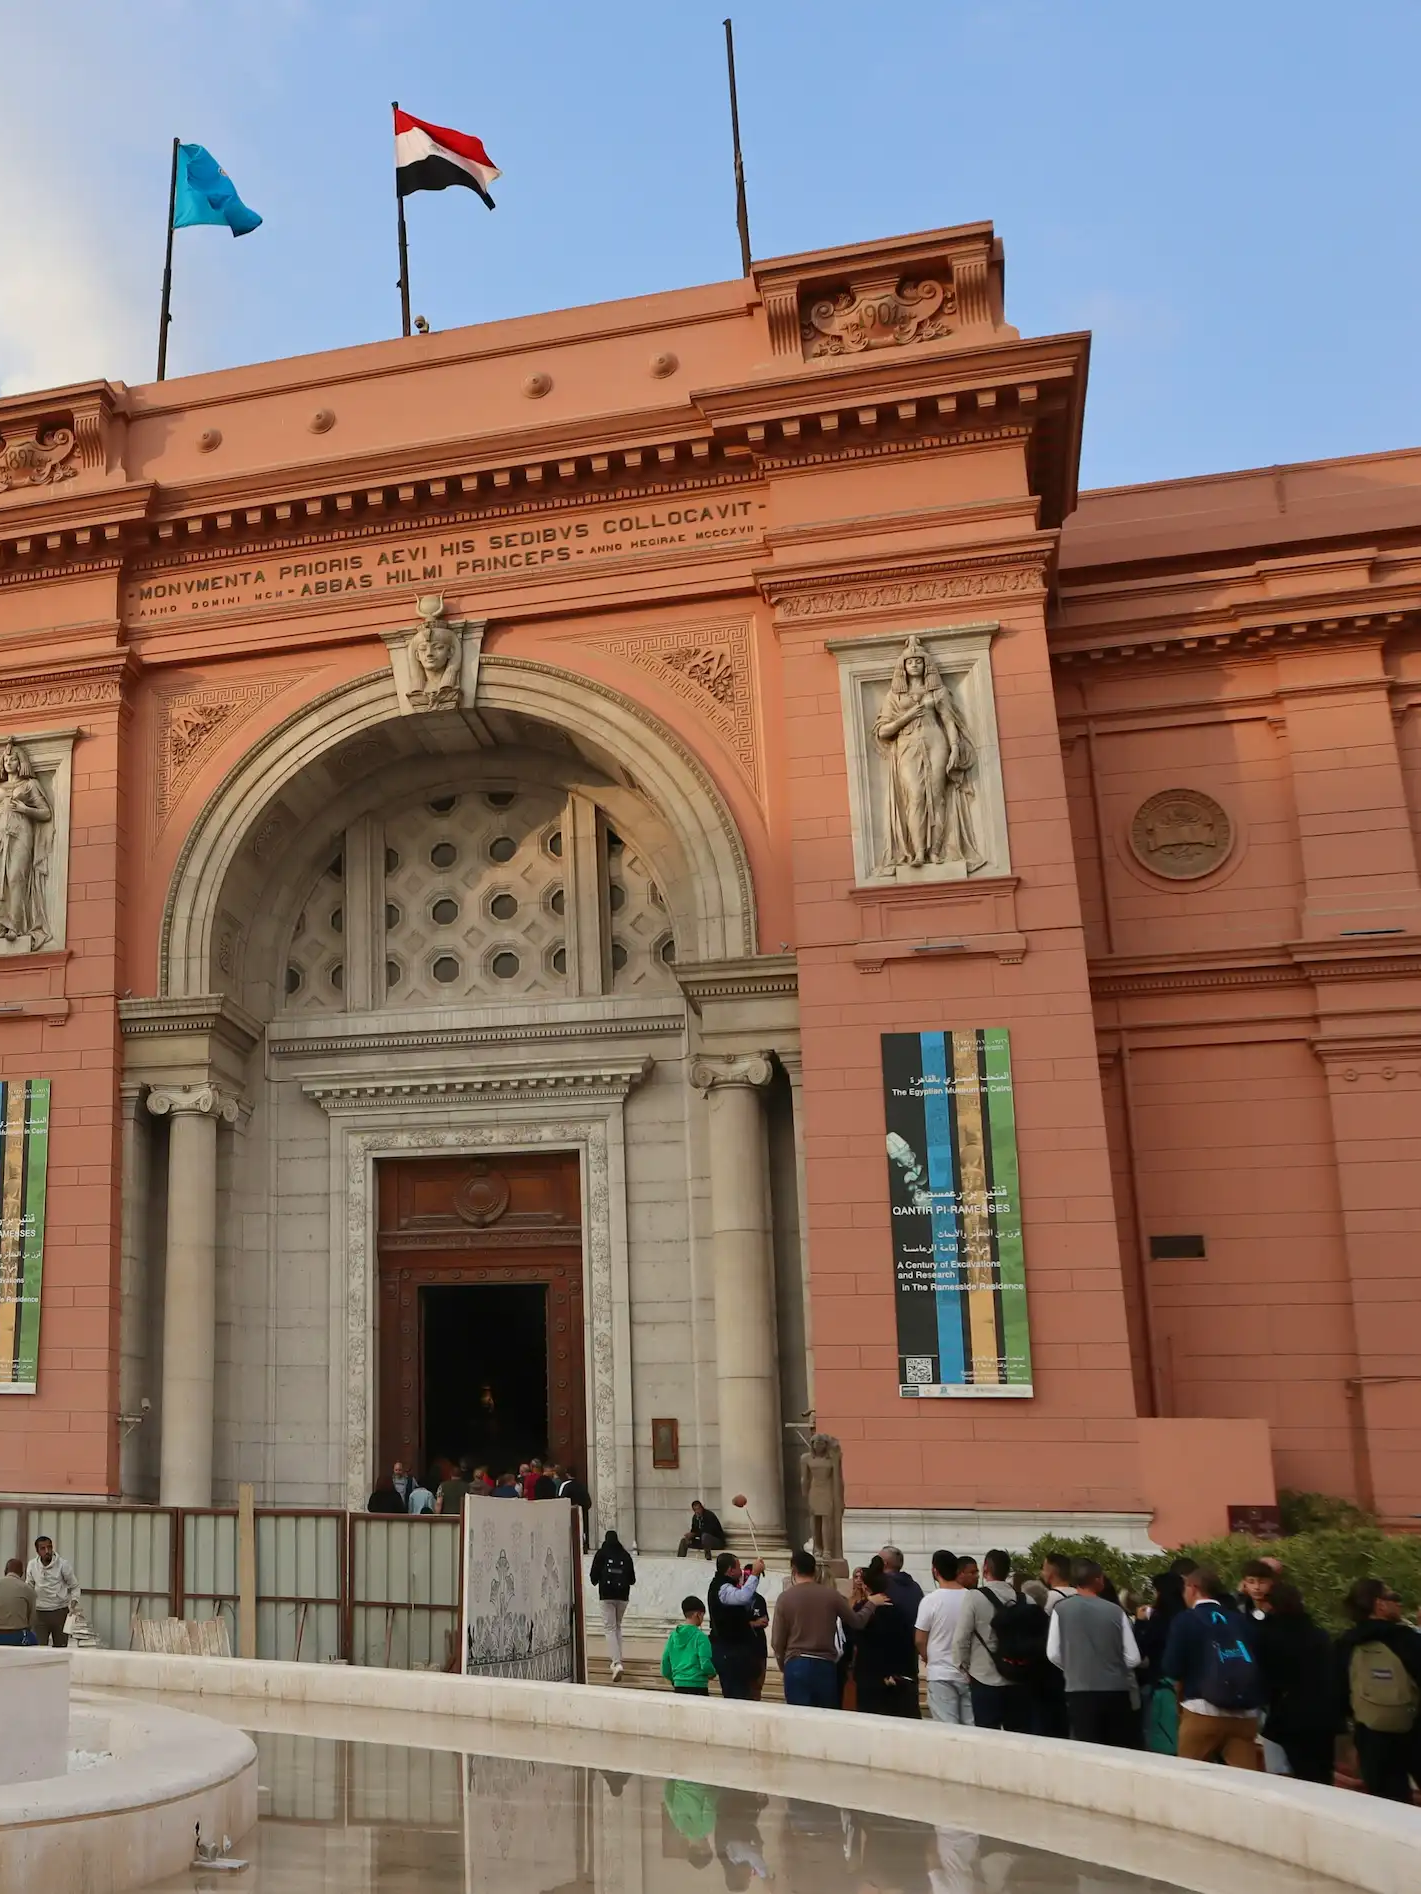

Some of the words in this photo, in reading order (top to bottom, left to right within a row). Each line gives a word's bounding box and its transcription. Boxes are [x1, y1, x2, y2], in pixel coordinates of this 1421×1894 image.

[139, 570, 266, 601] MONVMENTA
[279, 555, 363, 580] PRIORIS
[377, 545, 427, 567] AEVI
[440, 538, 475, 557] HIS
[488, 522, 589, 550] SEDIBVS
[602, 501, 752, 534] COLLOCAVIT
[140, 604, 178, 617] ANNO
[191, 596, 241, 610] DOMINI
[300, 574, 373, 597] ABBAS
[385, 564, 443, 585] HILMI
[456, 546, 571, 575] PRINCEPS
[589, 543, 622, 555] ANNO
[630, 534, 687, 549] HEGIRAE
[695, 525, 754, 540] MCCCXVII
[892, 1088, 908, 1096] The
[909, 1087, 943, 1097] Egyptian
[945, 1086, 980, 1094] Museum
[981, 1085, 988, 1093] in
[990, 1085, 1012, 1093] Cairo
[892, 1205, 934, 1216] QANTIR
[936, 1203, 1011, 1215] PI-RAMESSES
[897, 1261, 904, 1269] A
[905, 1261, 938, 1270] Century
[940, 1260, 949, 1268] of
[950, 1259, 1001, 1268] Excavations
[898, 1271, 914, 1279] and
[915, 1270, 955, 1279] Research
[912, 1283, 928, 1291] The
[930, 1282, 977, 1291] Ramesside
[980, 1281, 1024, 1291] Residence
[5, 1295, 39, 1303] Residence
